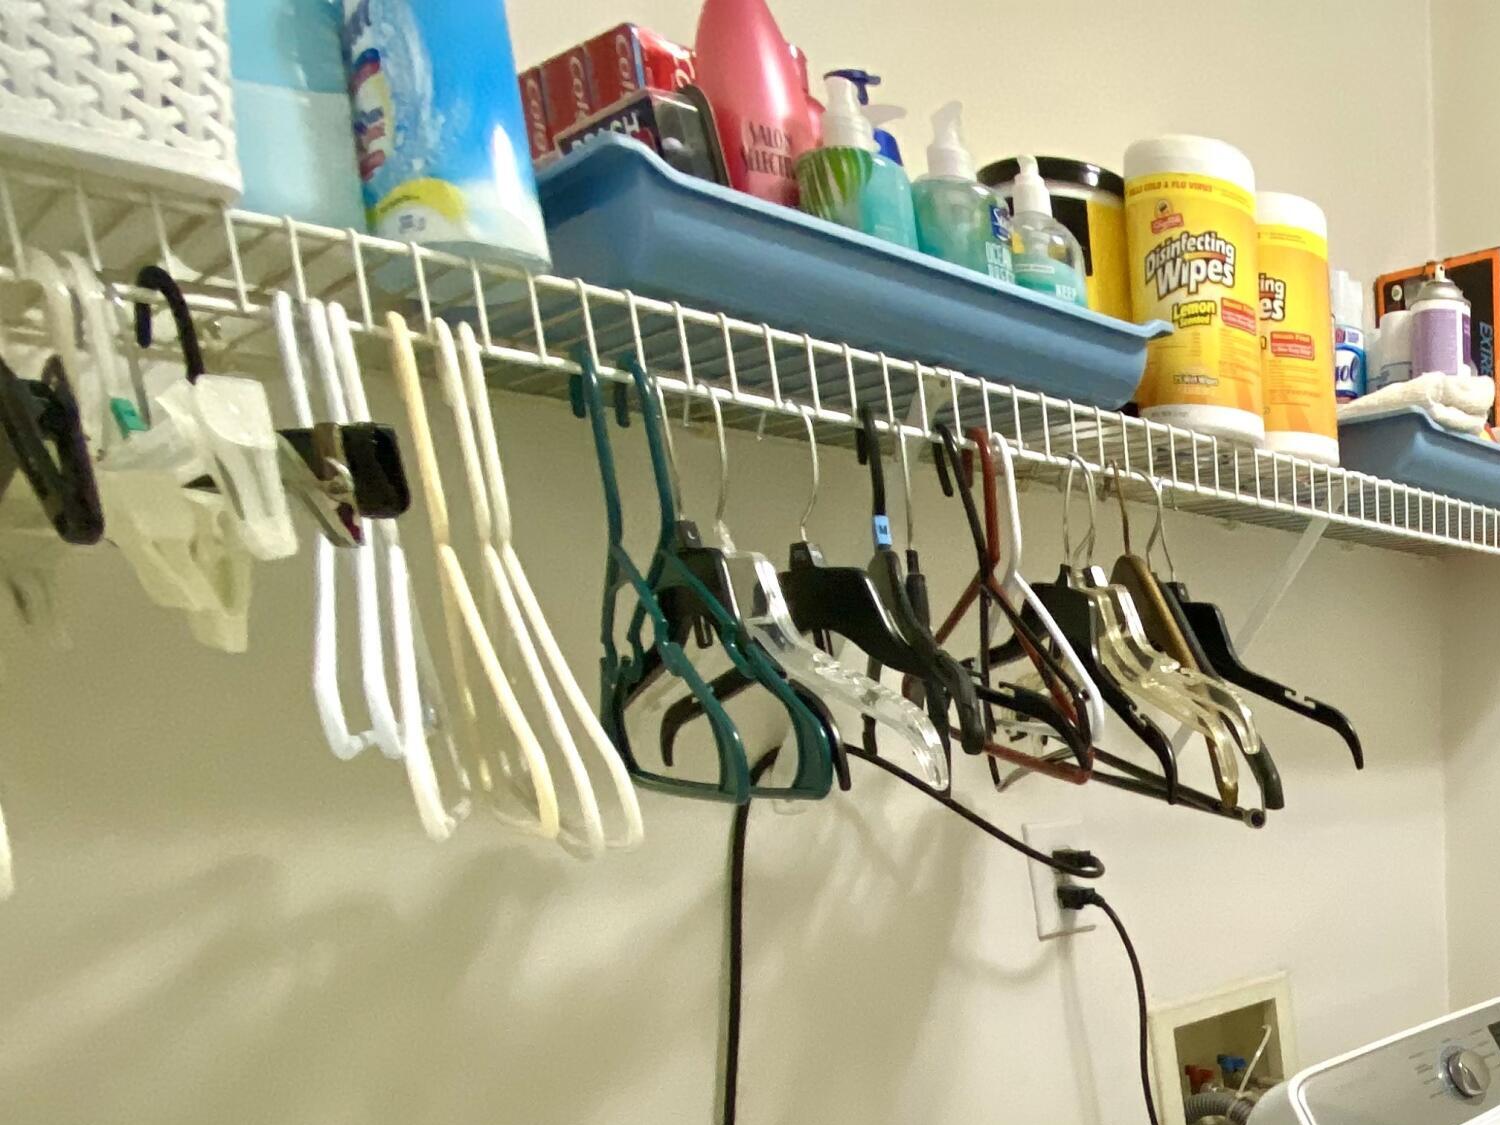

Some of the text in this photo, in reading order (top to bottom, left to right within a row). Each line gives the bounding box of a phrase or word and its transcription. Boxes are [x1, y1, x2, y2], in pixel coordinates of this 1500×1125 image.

[1145, 231, 1236, 285] Disinfecting
[1155, 258, 1236, 301] Wipes
[1171, 300, 1217, 323] Lemon
